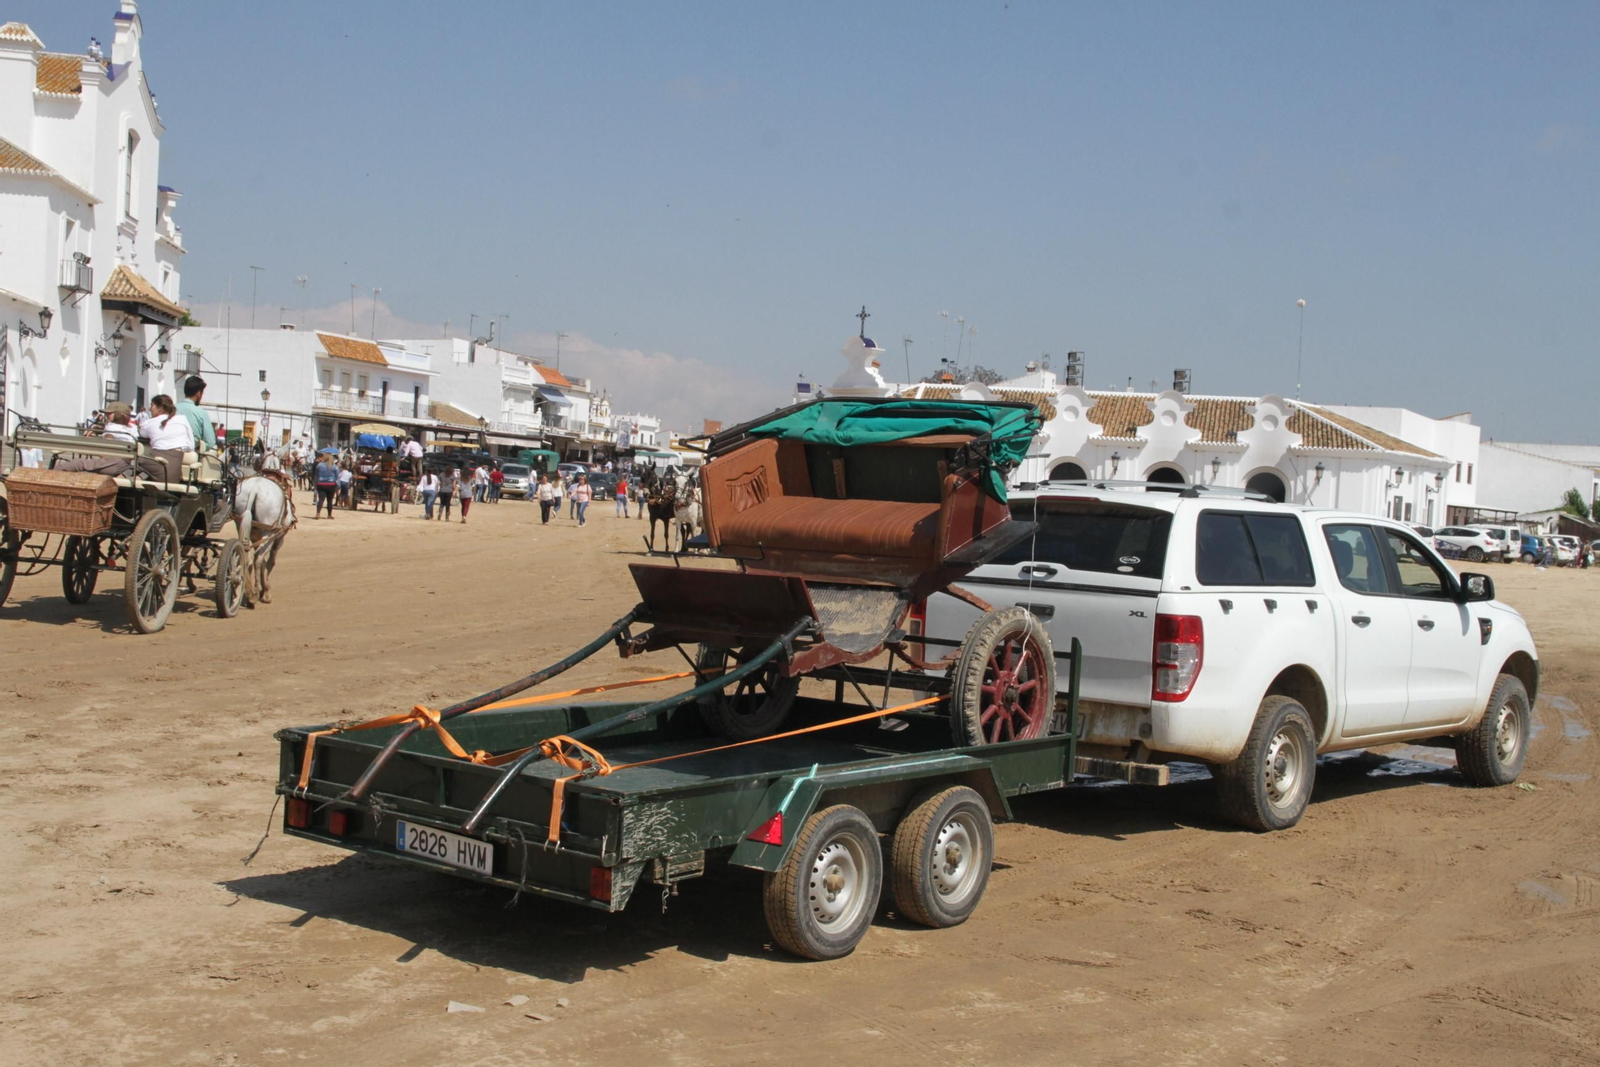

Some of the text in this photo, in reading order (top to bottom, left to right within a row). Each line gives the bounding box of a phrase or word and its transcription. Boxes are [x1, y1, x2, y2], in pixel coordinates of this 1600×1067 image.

[1128, 609, 1148, 619] XL
[409, 827, 487, 870] 2026 HVM
